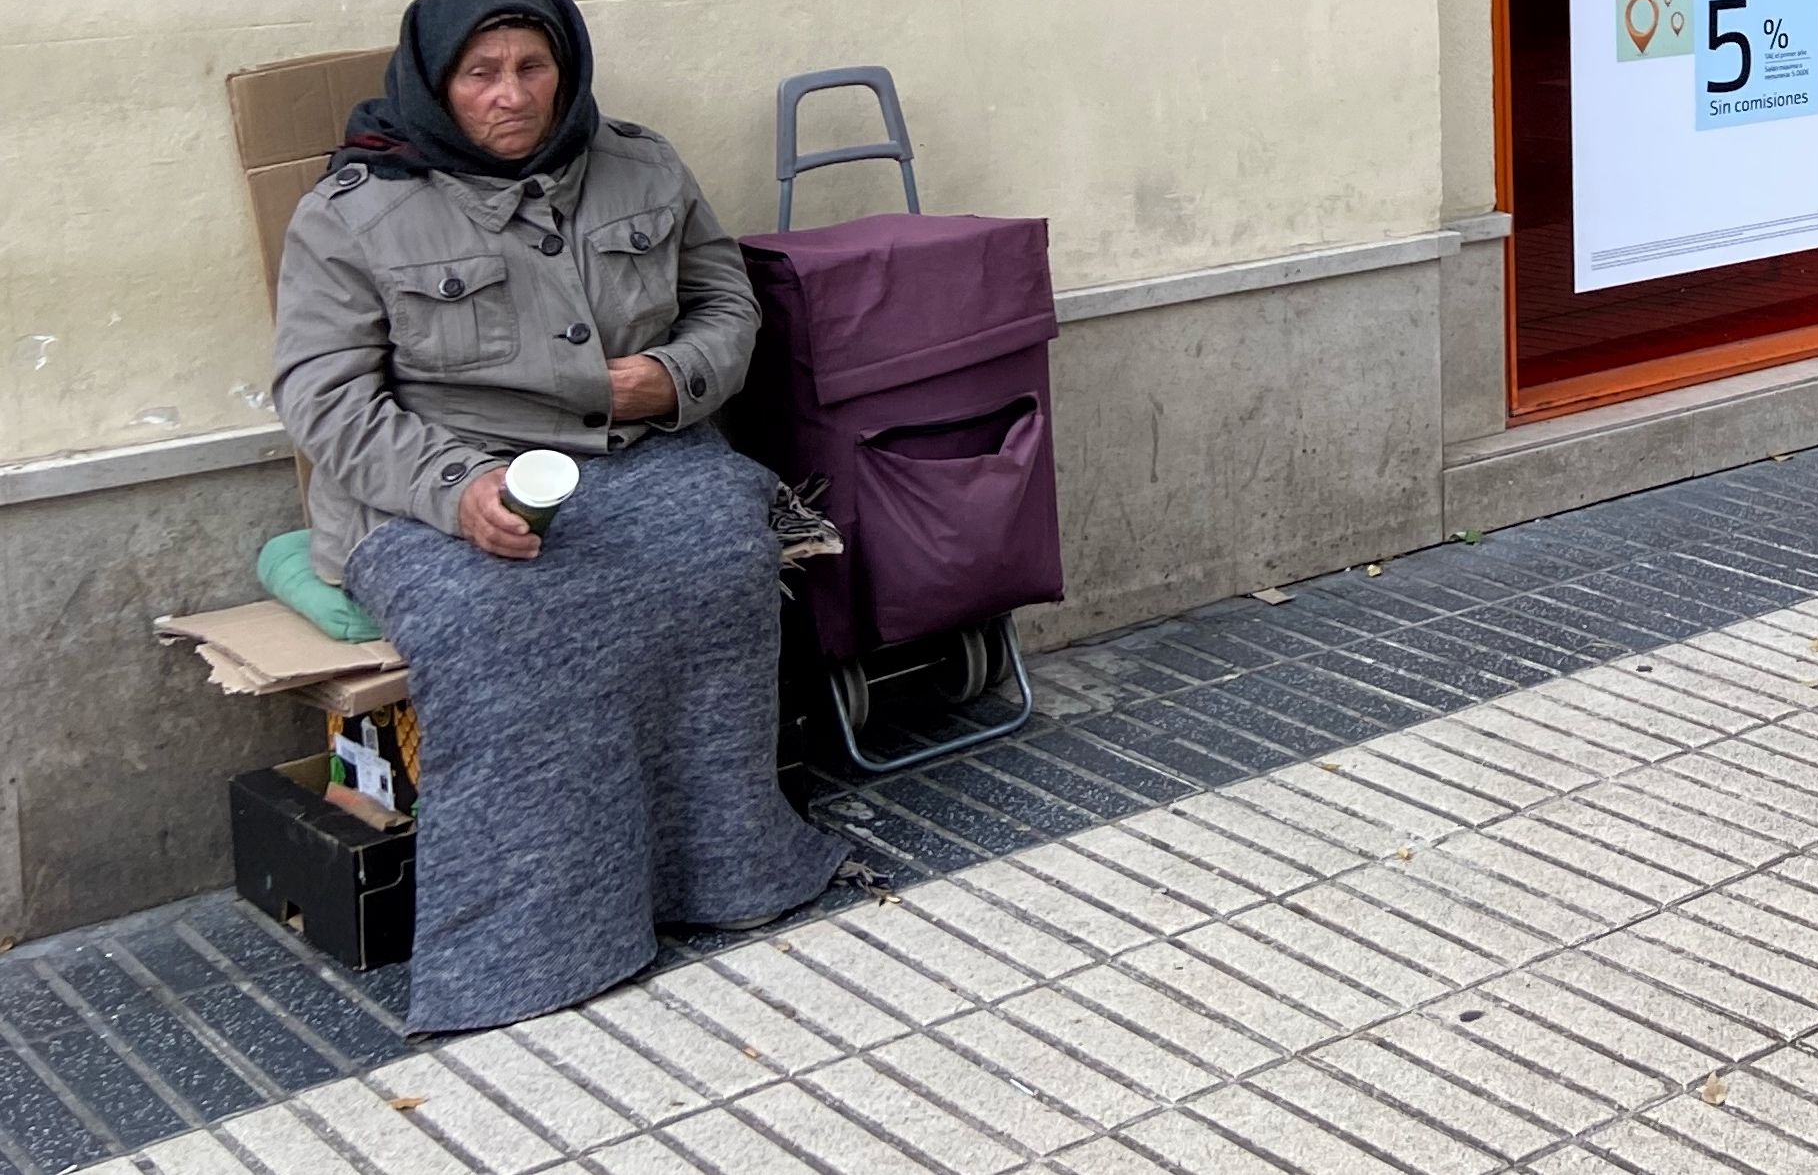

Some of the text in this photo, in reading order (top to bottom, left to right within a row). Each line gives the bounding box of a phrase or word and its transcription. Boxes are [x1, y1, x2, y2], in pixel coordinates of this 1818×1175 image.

[1763, 18, 1789, 50] %
[1709, 91, 1809, 116] Sin comisiones
